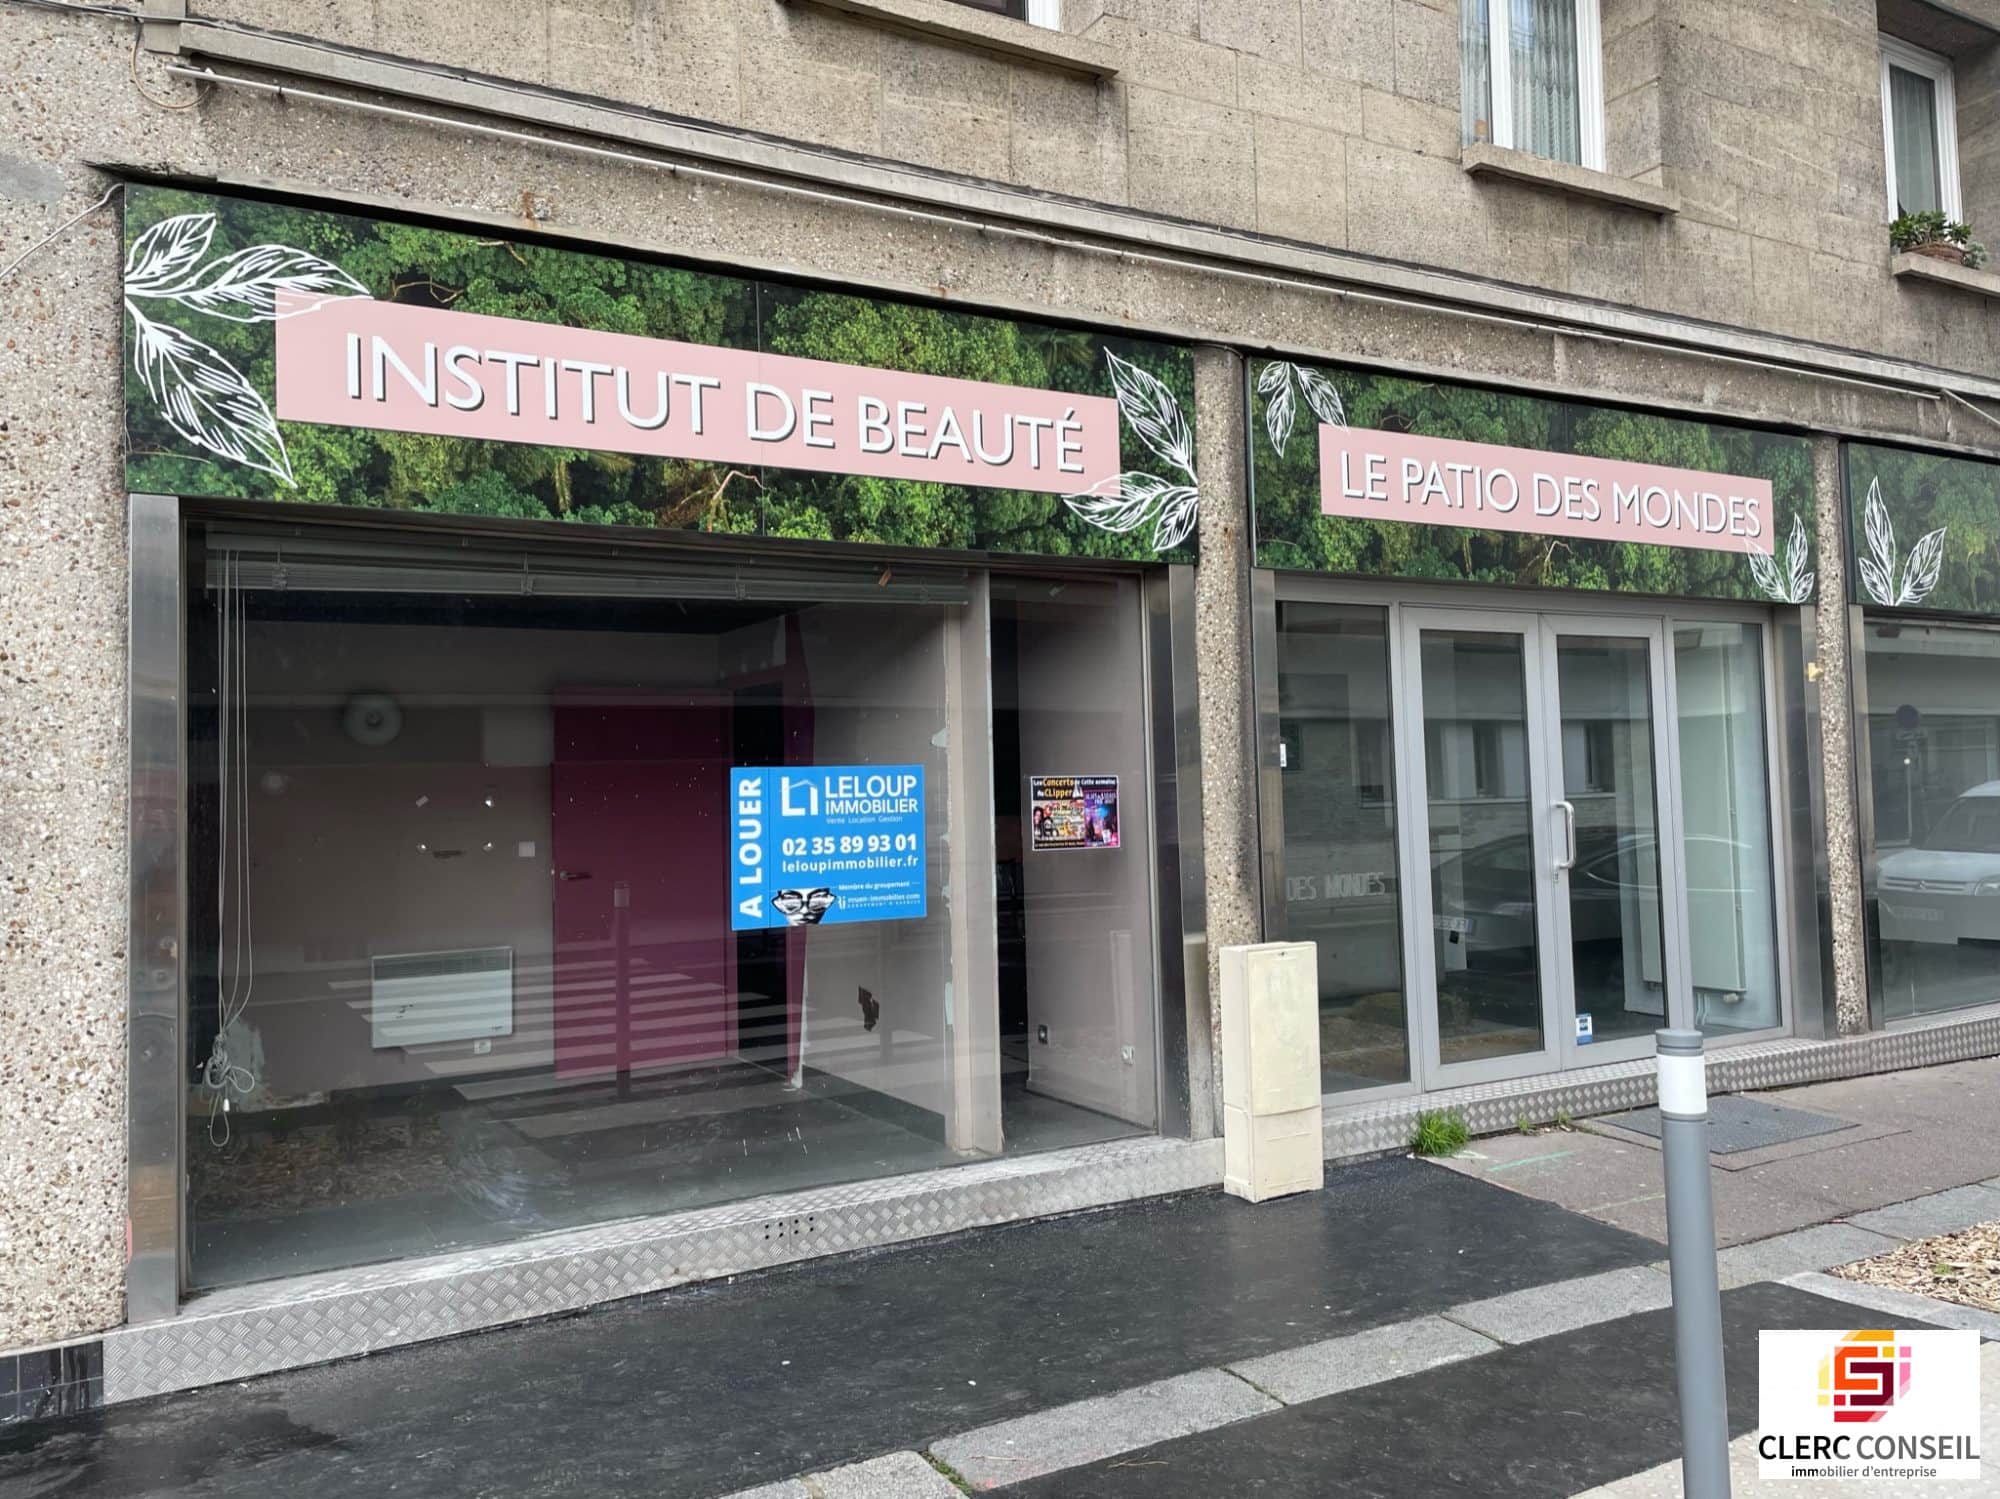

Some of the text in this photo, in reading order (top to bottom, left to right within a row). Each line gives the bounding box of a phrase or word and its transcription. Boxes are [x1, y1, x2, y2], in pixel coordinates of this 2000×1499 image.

[346, 332, 1085, 474] INSTITUT DE BEAUTÉ
[1341, 450, 1762, 538] LE PATIO DES MONDES
[824, 775, 917, 798] LELOUP
[1042, 778, 1074, 787] Concerts
[825, 799, 919, 815] IMMOBILIER
[739, 777, 763, 919] A LOUER
[782, 833, 917, 856] 02 35 89 93 01
[782, 855, 919, 874] leloupimmobilier.fr
